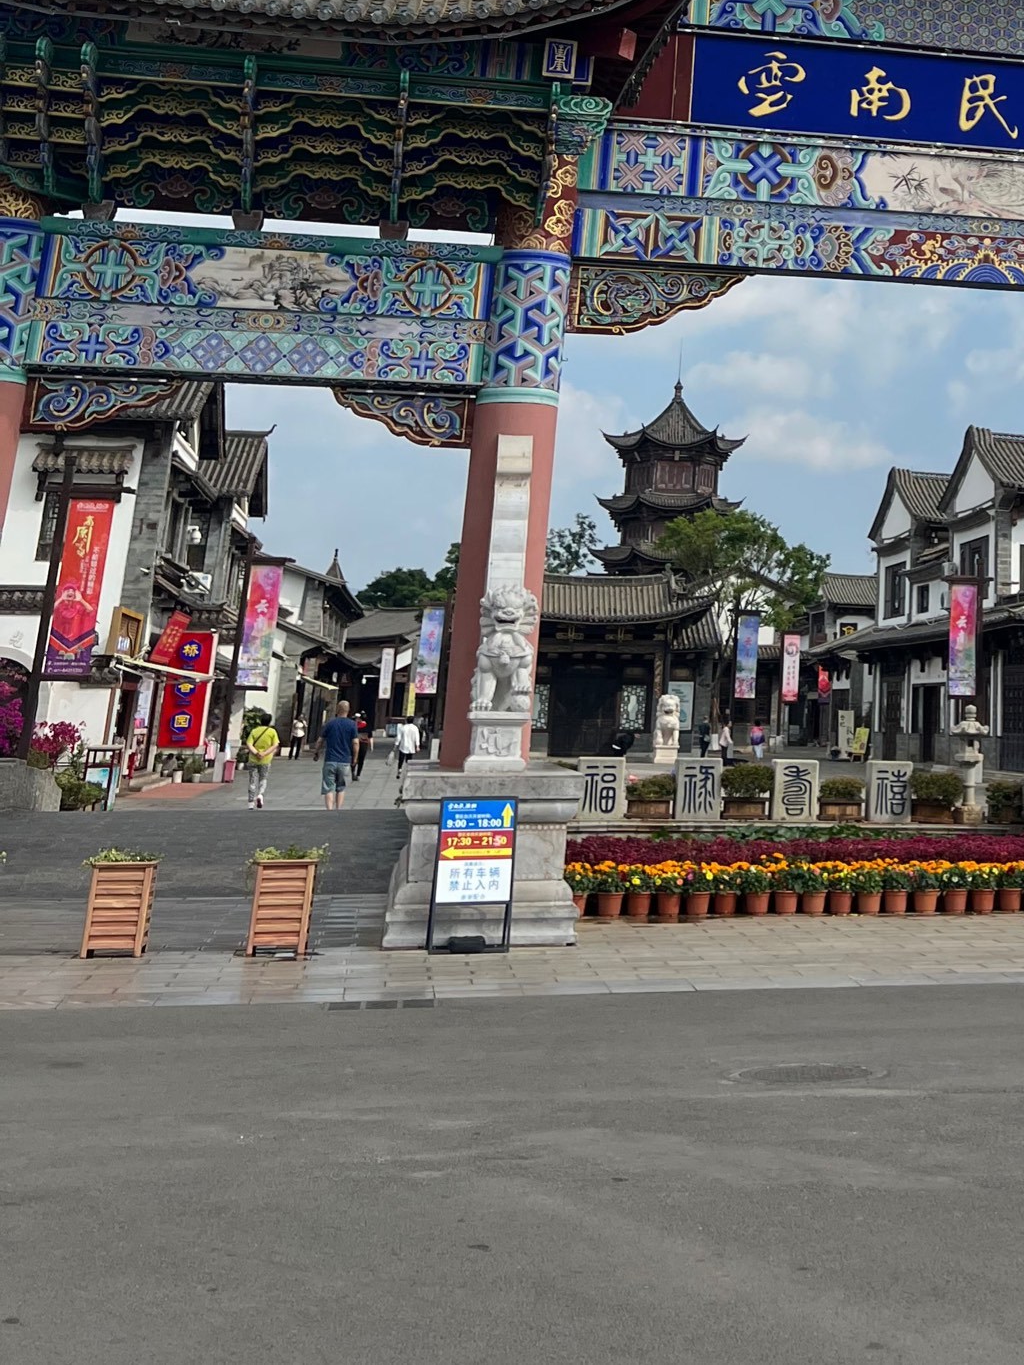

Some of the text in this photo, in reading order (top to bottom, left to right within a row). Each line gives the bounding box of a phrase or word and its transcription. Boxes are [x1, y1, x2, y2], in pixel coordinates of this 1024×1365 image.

[447, 837, 472, 846] 17:30
[449, 866, 500, 879] 所有车辆
[449, 880, 499, 891] 禁止入内
